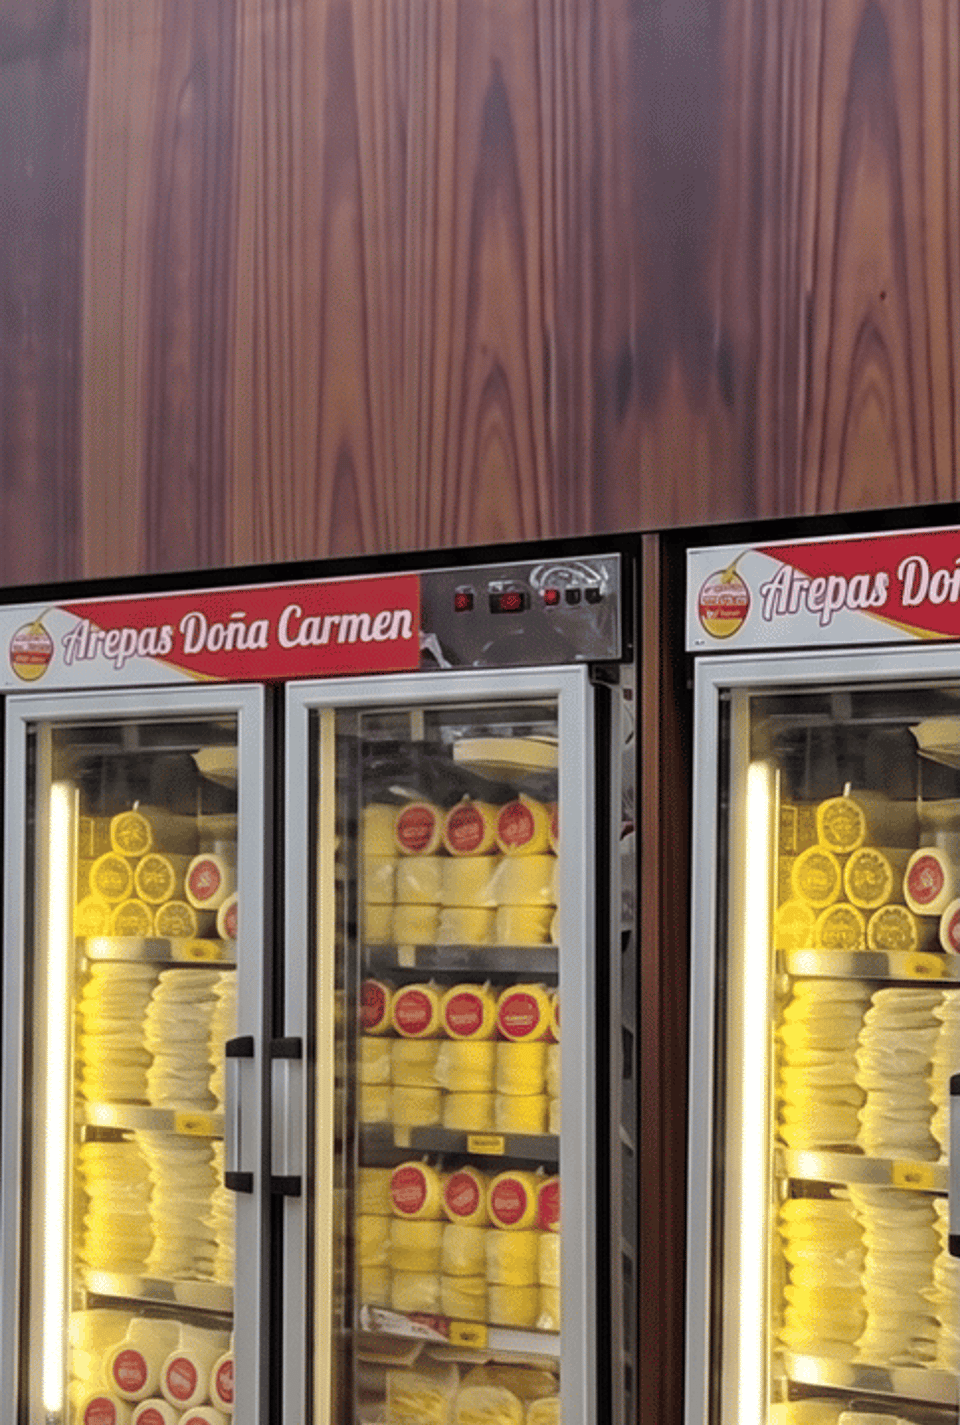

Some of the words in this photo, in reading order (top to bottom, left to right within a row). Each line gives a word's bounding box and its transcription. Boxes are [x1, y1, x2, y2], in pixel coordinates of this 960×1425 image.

[760, 564, 889, 626] Arepas
[62, 619, 173, 669] Arepas
[180, 612, 269, 654] Doña
[278, 604, 412, 649] Carmen
